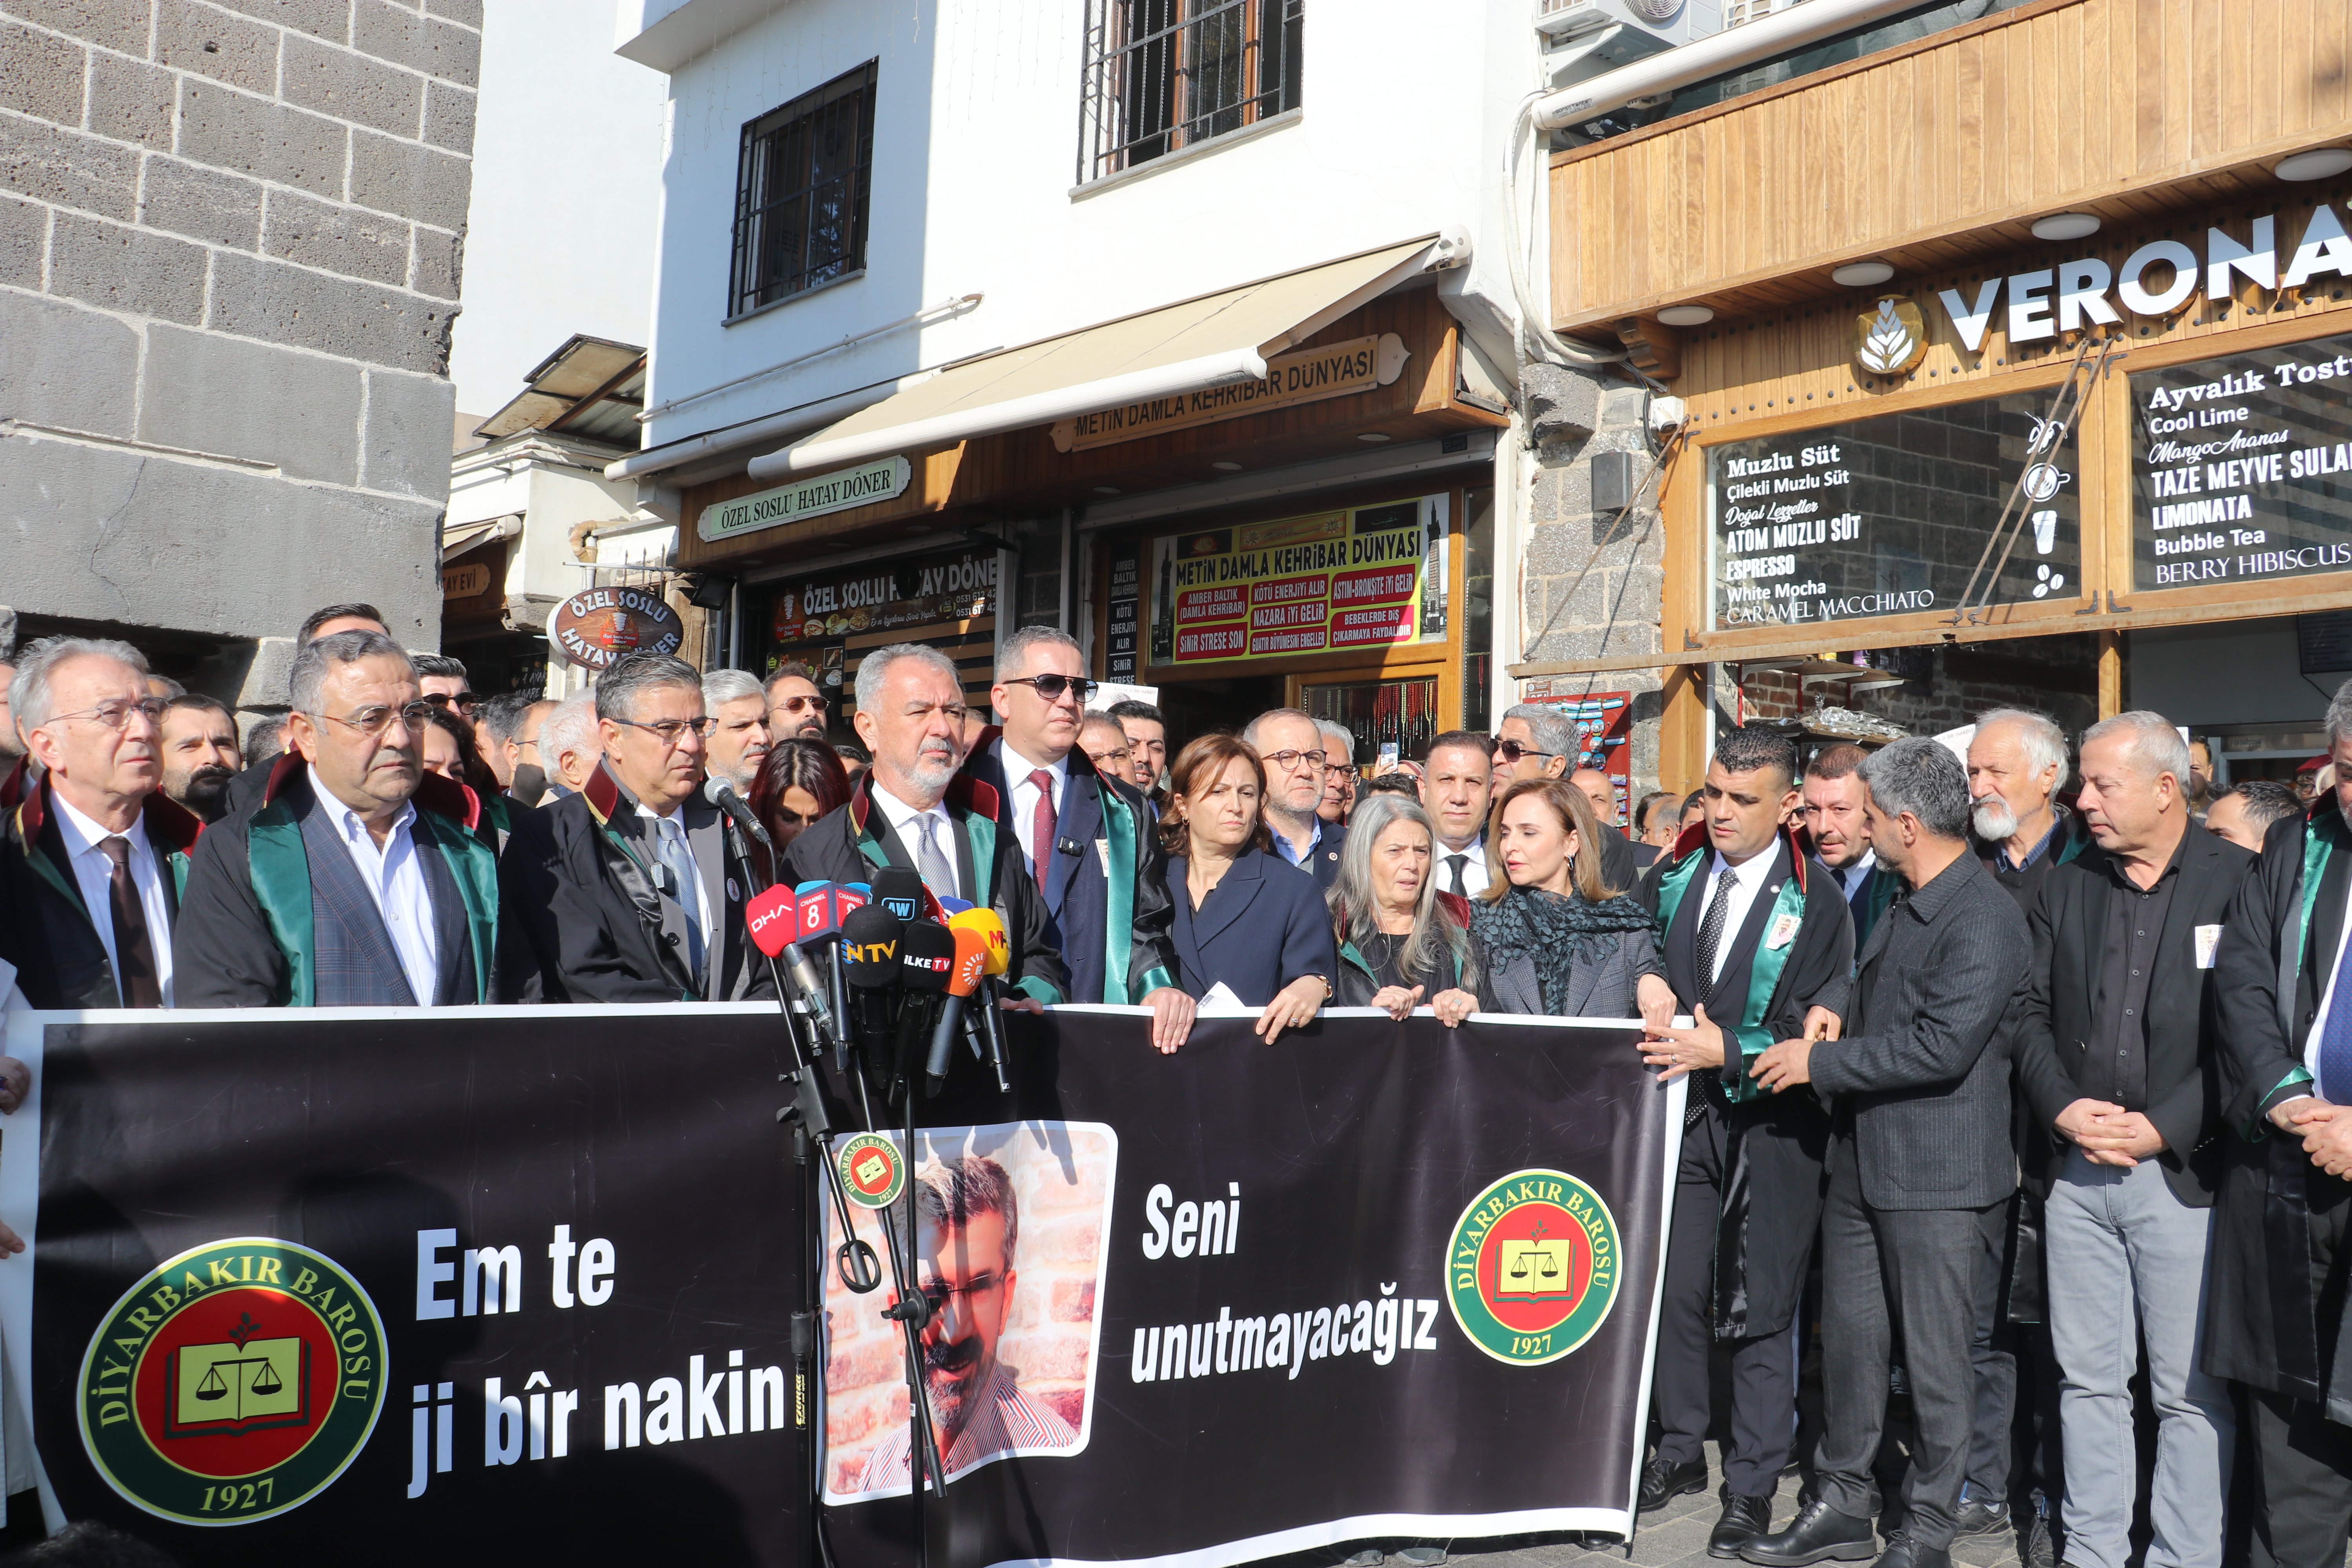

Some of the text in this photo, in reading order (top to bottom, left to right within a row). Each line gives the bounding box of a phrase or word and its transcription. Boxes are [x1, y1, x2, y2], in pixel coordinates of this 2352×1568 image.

[1938, 203, 2352, 353] VERONA
[1128, 396, 1184, 426] DAMLA
[1288, 348, 1374, 392] DÜNYASI
[2149, 369, 2266, 412] Ayvalık
[2150, 407, 2249, 434] Cool Lime
[1727, 443, 1840, 478] Muzlu Süt
[1727, 469, 1850, 503] Çilekli Muzlu Süt
[2151, 465, 2201, 498] TAZE
[2208, 453, 2283, 491] MEYVE
[721, 469, 891, 529] ÖZEL SOSLU HATAY DÖNER
[1725, 505, 1765, 528] Doğal
[1726, 513, 1861, 554] ATOM MUZLU SÜT
[2155, 528, 2266, 556] Bubble Tea
[1116, 559, 1135, 572] AMBER
[1220, 552, 1269, 582] DAMLA
[1352, 529, 1421, 564] DÜNYASI
[1726, 554, 1795, 581] ESPRESSO
[2156, 543, 2351, 584] BERRY HIBISCUS
[804, 583, 838, 615] ÖZEL
[842, 576, 885, 610] SOSLU
[889, 566, 944, 601] HAY
[1114, 571, 1136, 584] BALTIK
[1254, 584, 1273, 601] KÖTÜ
[1308, 580, 1325, 596] ALIR
[1726, 579, 1827, 603] White Mocha
[569, 591, 669, 623] ÖZEL SOSLU
[956, 595, 971, 603] 0531
[1188, 588, 1238, 605] AMBER BALTIK
[1726, 589, 1935, 624] CARAMEL MACCHIATO
[956, 608, 971, 617] 0531
[972, 604, 984, 615] 617
[1116, 604, 1132, 619] KÖTÜ
[1180, 605, 1207, 621] (DAMLA
[1254, 606, 1286, 627] NAZARA
[1345, 611, 1388, 626] BEBEKLERDE
[561, 628, 618, 665] HATAY
[1116, 637, 1129, 650] ALIR
[1200, 632, 1227, 651] STRESE
[1229, 630, 1243, 649] SON
[1252, 637, 1269, 652] GUATIR
[1300, 632, 1325, 648] ENGELLER
[1333, 624, 1412, 645] ÇIKARMAYA FAYDALIDIR
[800, 893, 826, 907] CHANNEL
[838, 892, 864, 905] CHANNEL
[751, 904, 793, 933] DHA
[807, 904, 820, 928] 8
[846, 939, 897, 963] NTV
[842, 1138, 899, 1193] DİYARBAKIR BAROSU
[878, 1188, 894, 1203] 1927
[1141, 1180, 1240, 1260] Seni
[1456, 1180, 1611, 1292] DİYARBAKIR BAROSU
[416, 1223, 615, 1321] Em te
[96, 1254, 368, 1430] DİYARBAKIR BAROSU
[1131, 1282, 1439, 1383] unutmayacağız
[1509, 1333, 1552, 1357] 1927
[407, 1347, 784, 1500] ji bîr nakin
[198, 1476, 275, 1514] 1927
